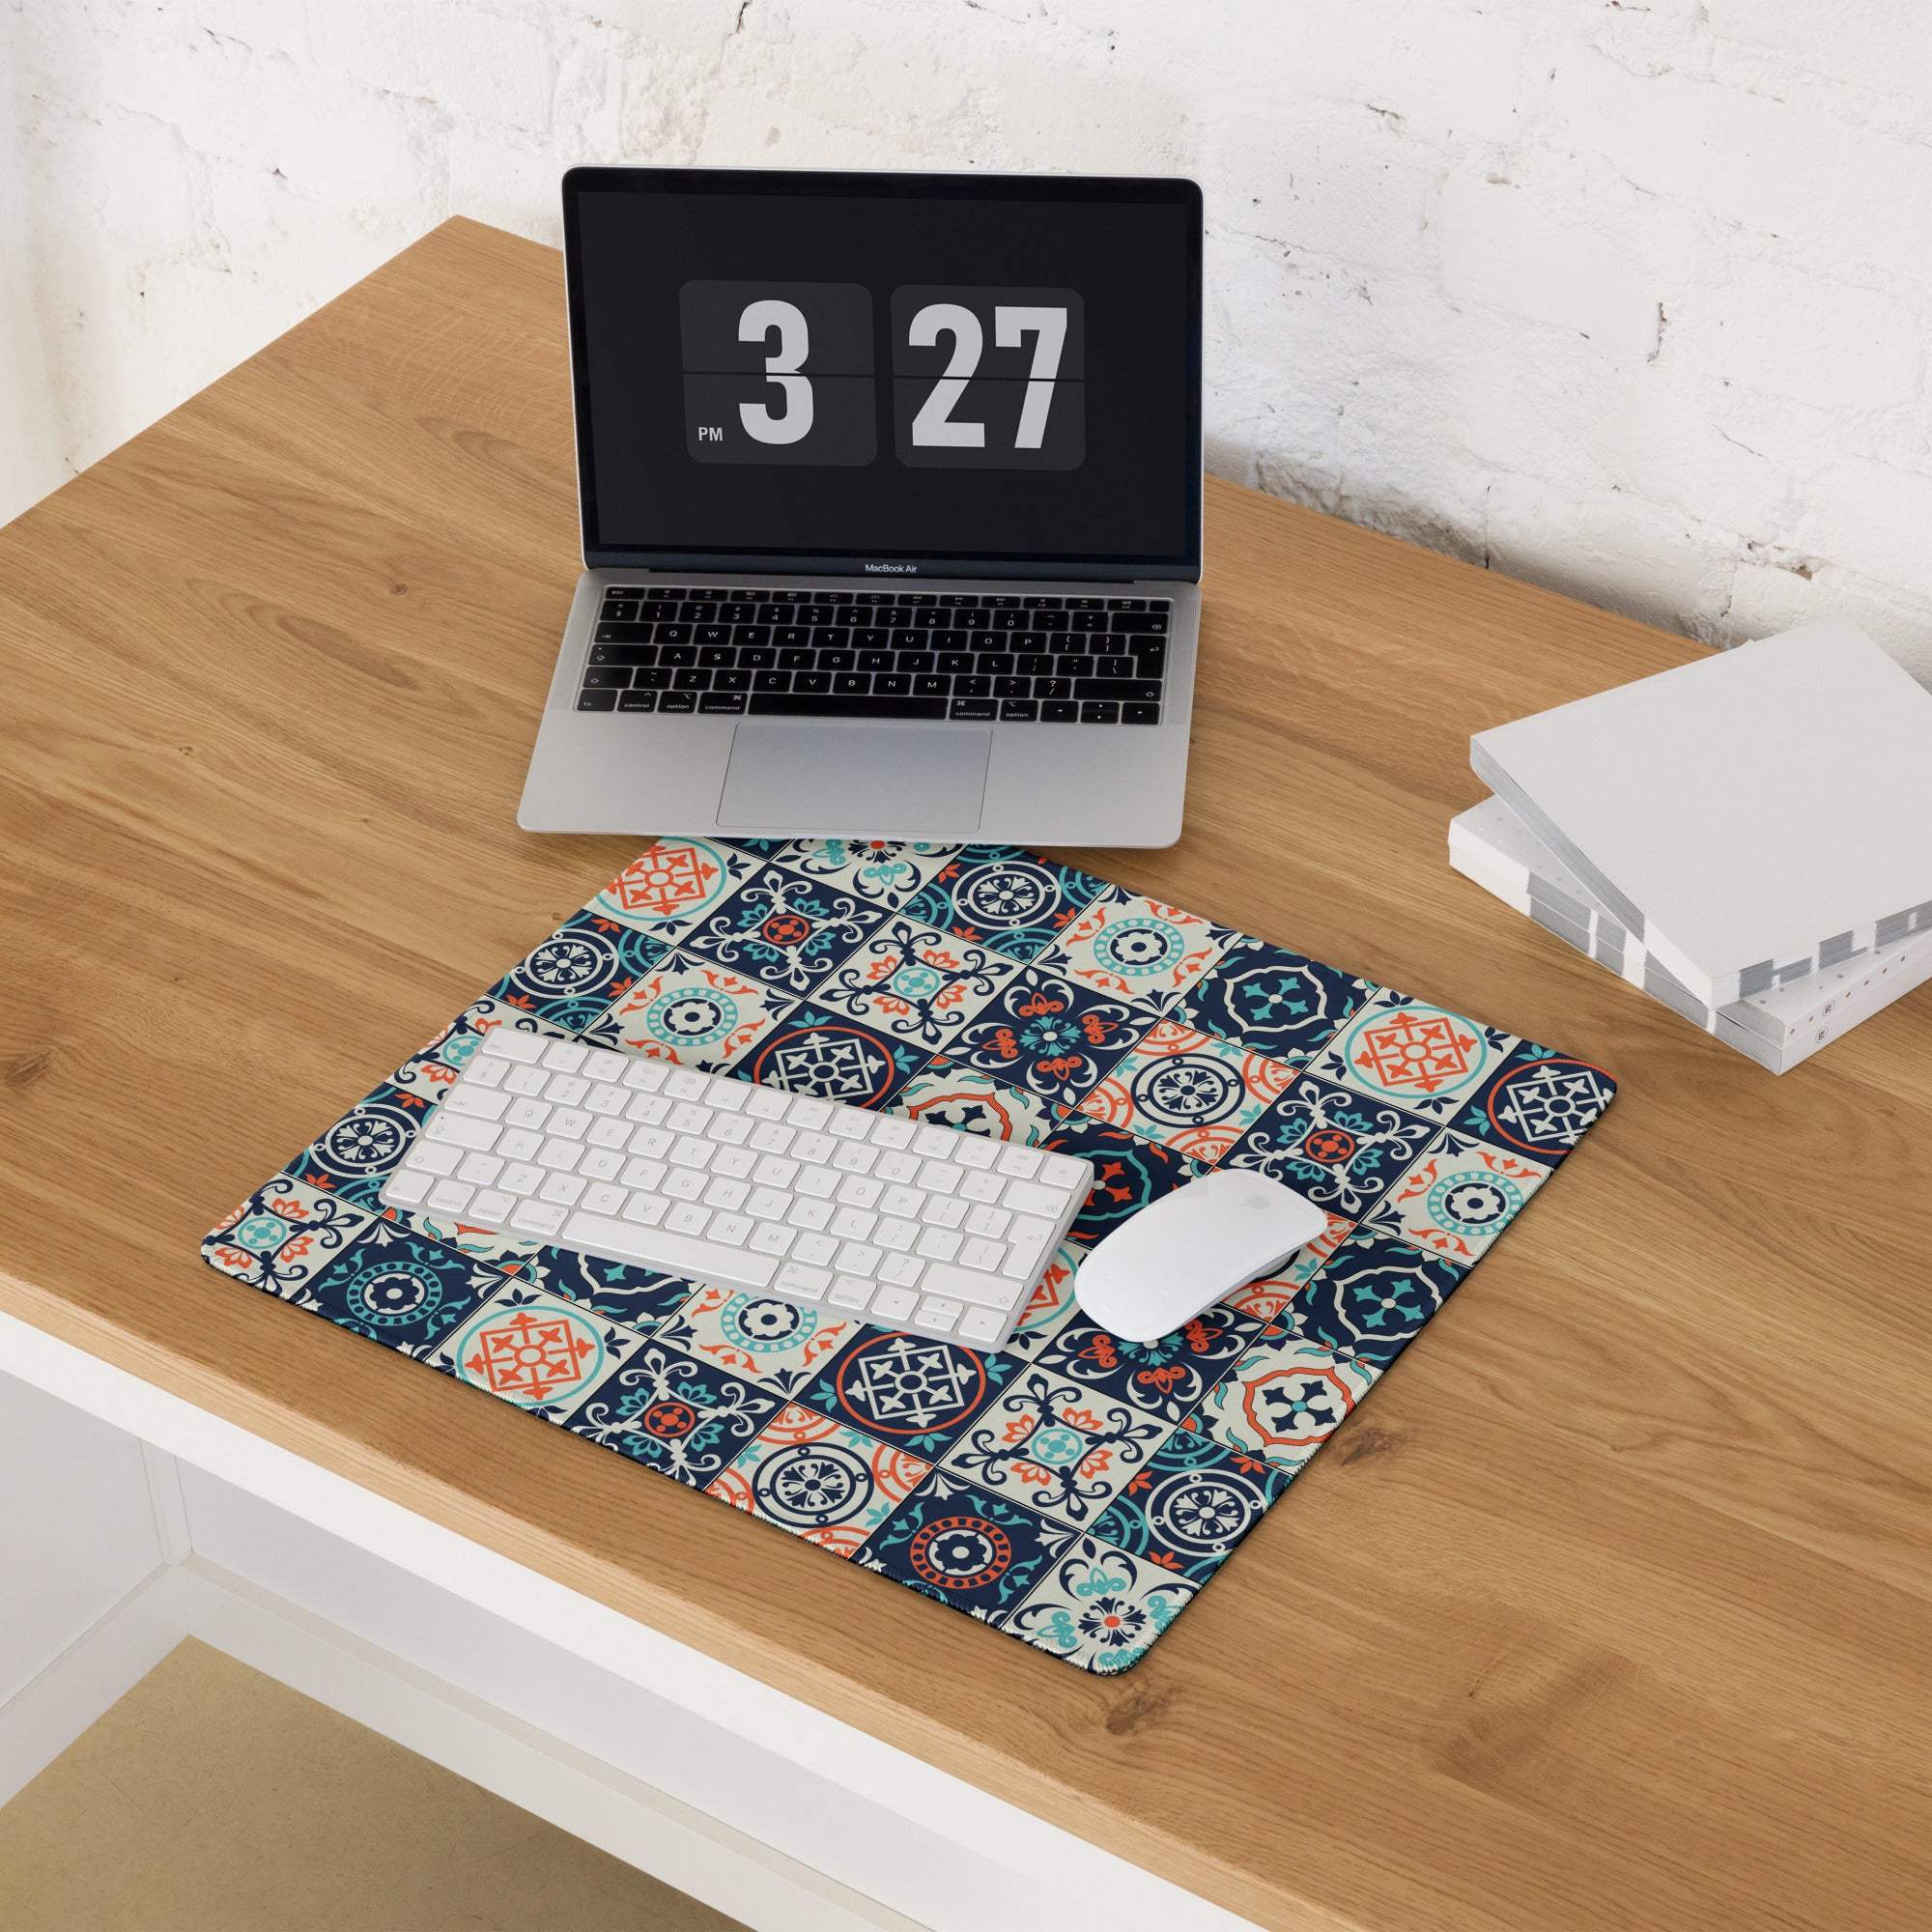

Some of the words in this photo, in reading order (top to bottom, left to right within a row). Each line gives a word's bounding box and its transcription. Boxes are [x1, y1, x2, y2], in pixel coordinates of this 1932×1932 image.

[738, 299, 814, 445] 3
[908, 303, 1067, 449] 27
[697, 426, 724, 441] PM
[865, 563, 904, 573] MacBook
[905, 564, 918, 573] Air
